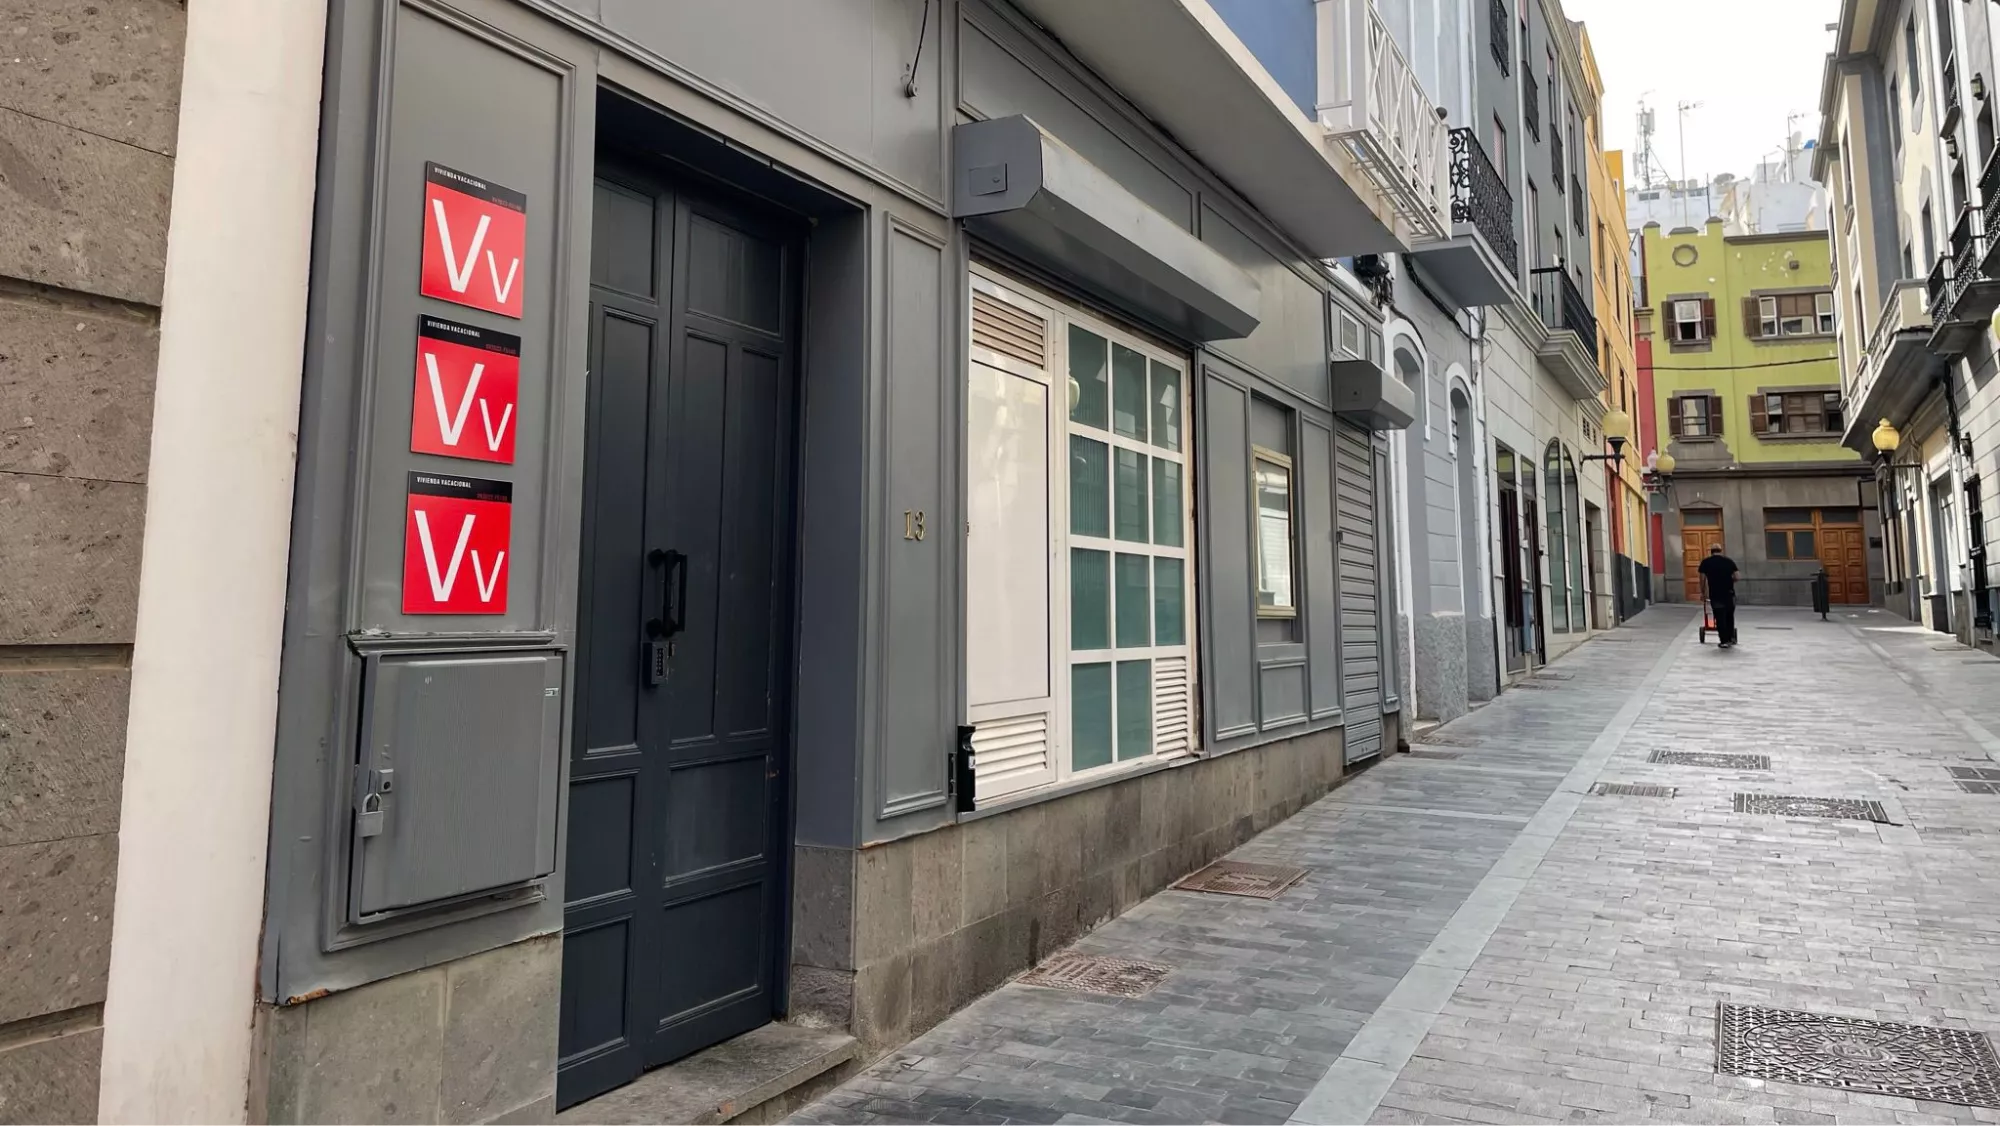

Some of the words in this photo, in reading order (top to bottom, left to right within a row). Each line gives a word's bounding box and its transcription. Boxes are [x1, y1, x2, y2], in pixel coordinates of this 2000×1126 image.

[434, 167, 457, 179] VIVIENDA
[457, 175, 487, 189] VACACIONAL
[427, 321, 450, 330] VIVIENDA
[451, 326, 480, 337] VACACIONAL
[417, 477, 440, 485] VIVIENDA
[441, 480, 471, 488] VACACIONAL
[903, 509, 925, 541] 13
